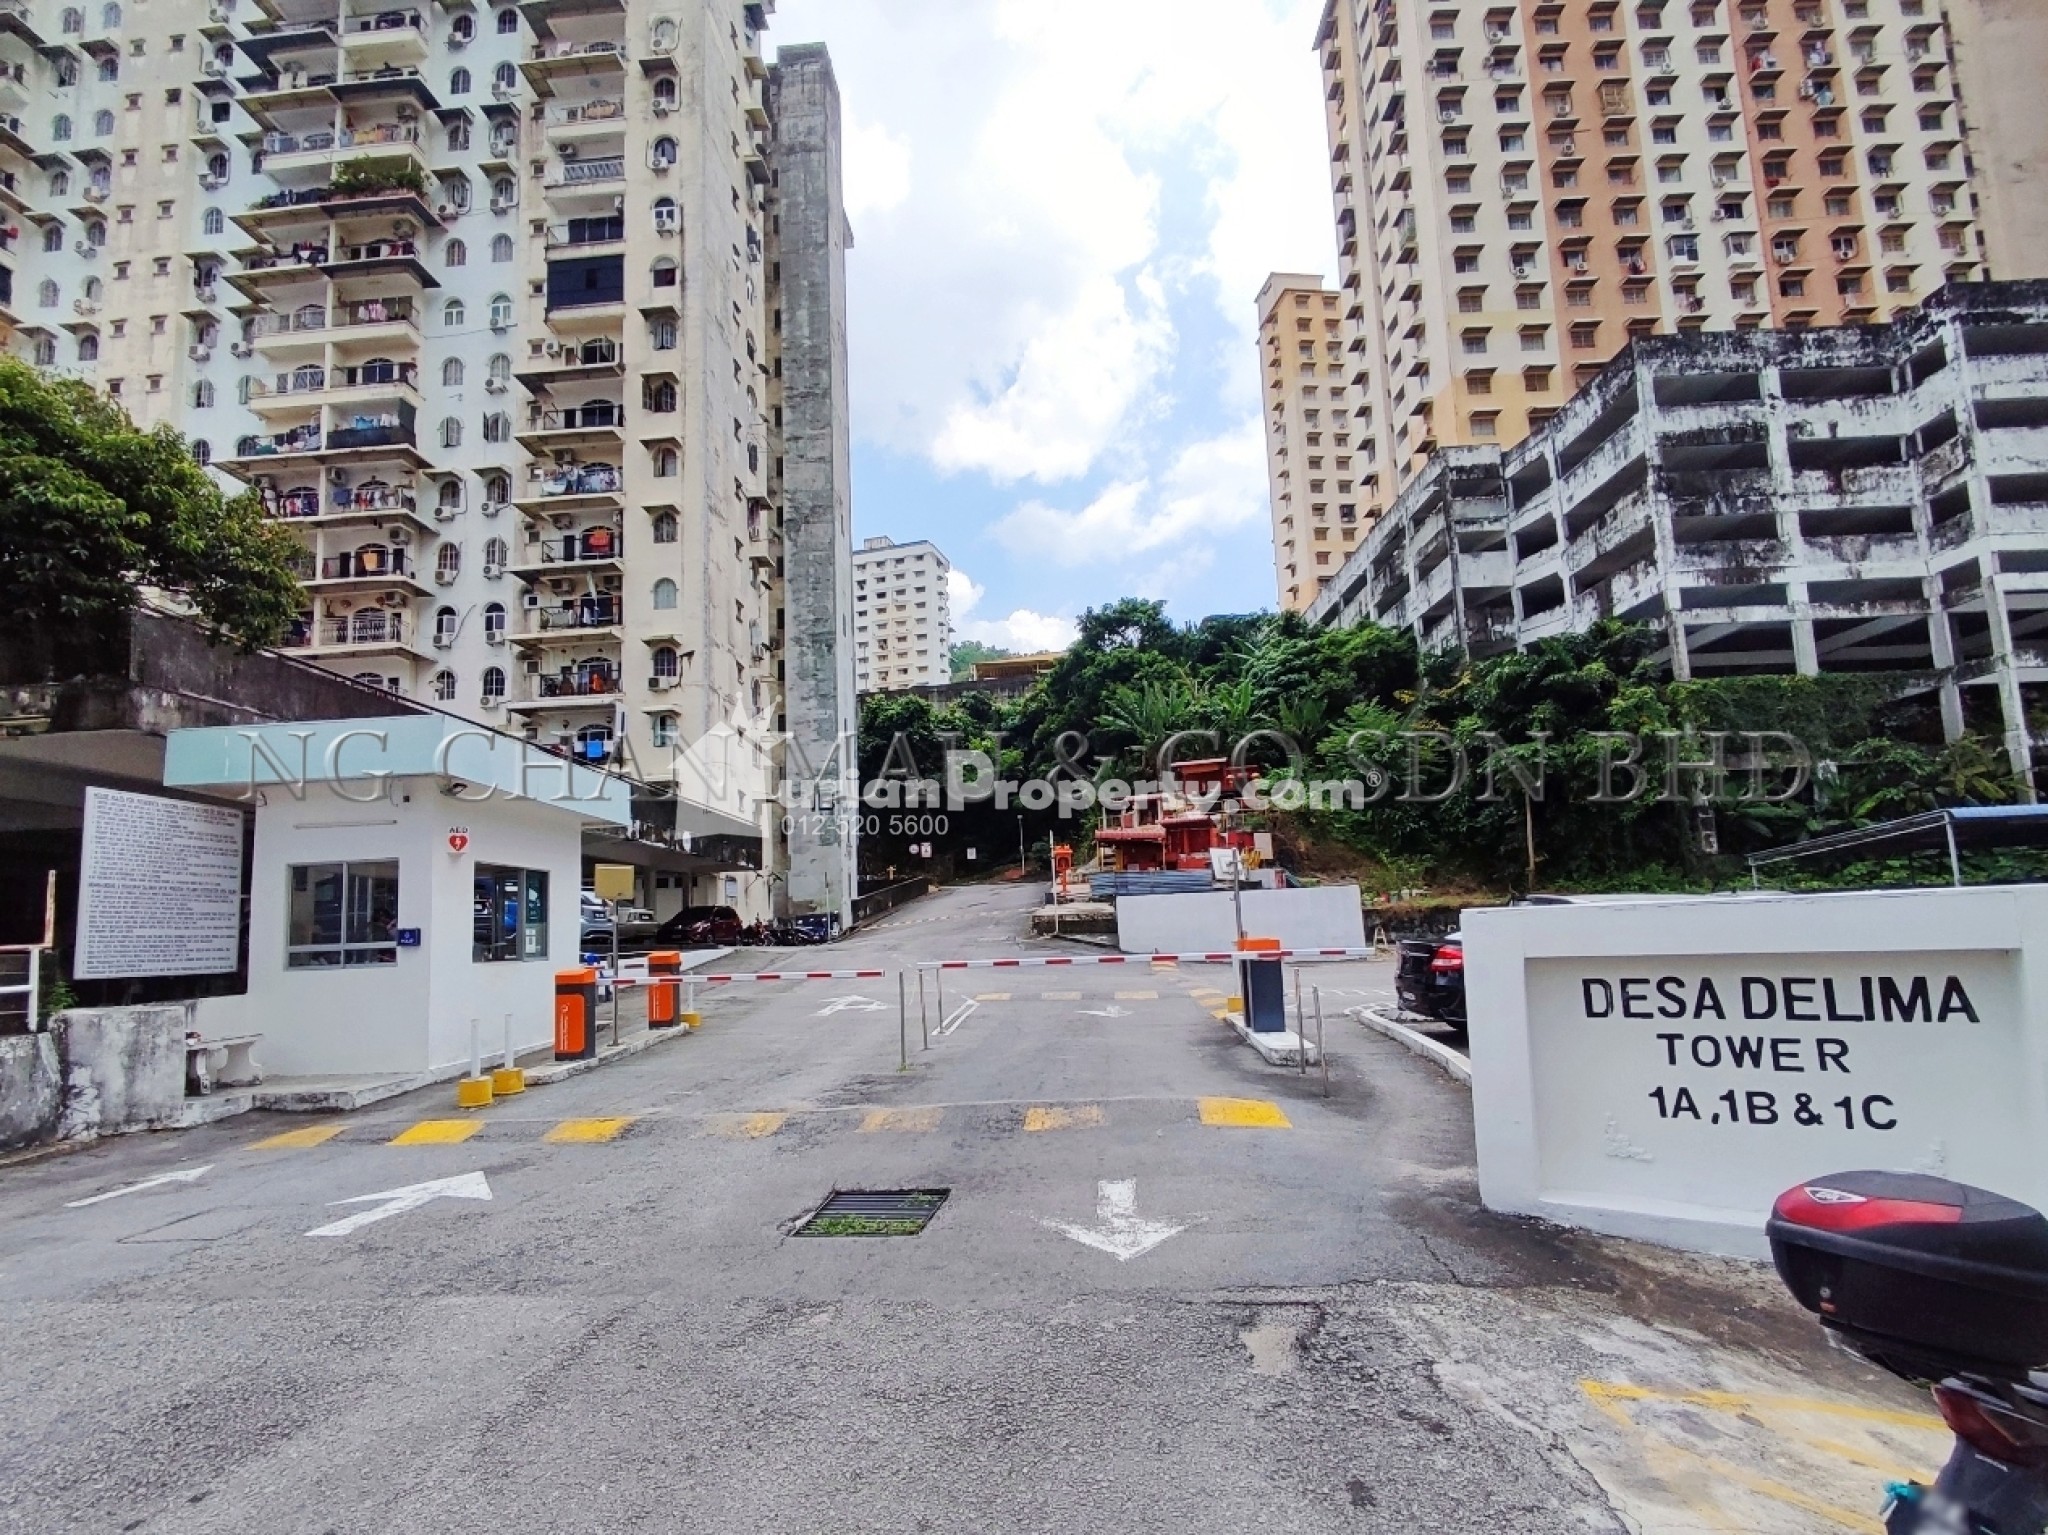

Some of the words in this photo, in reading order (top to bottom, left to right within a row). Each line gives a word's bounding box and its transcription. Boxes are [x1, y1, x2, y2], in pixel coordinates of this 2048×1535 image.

[449, 825, 469, 834] AED
[1582, 976, 1726, 1020] DESA
[1740, 975, 1980, 1023] DELIMA
[1656, 1033, 1851, 1073] TOWER
[1793, 1093, 1824, 1126] &
[1834, 1094, 1897, 1130] 1C
